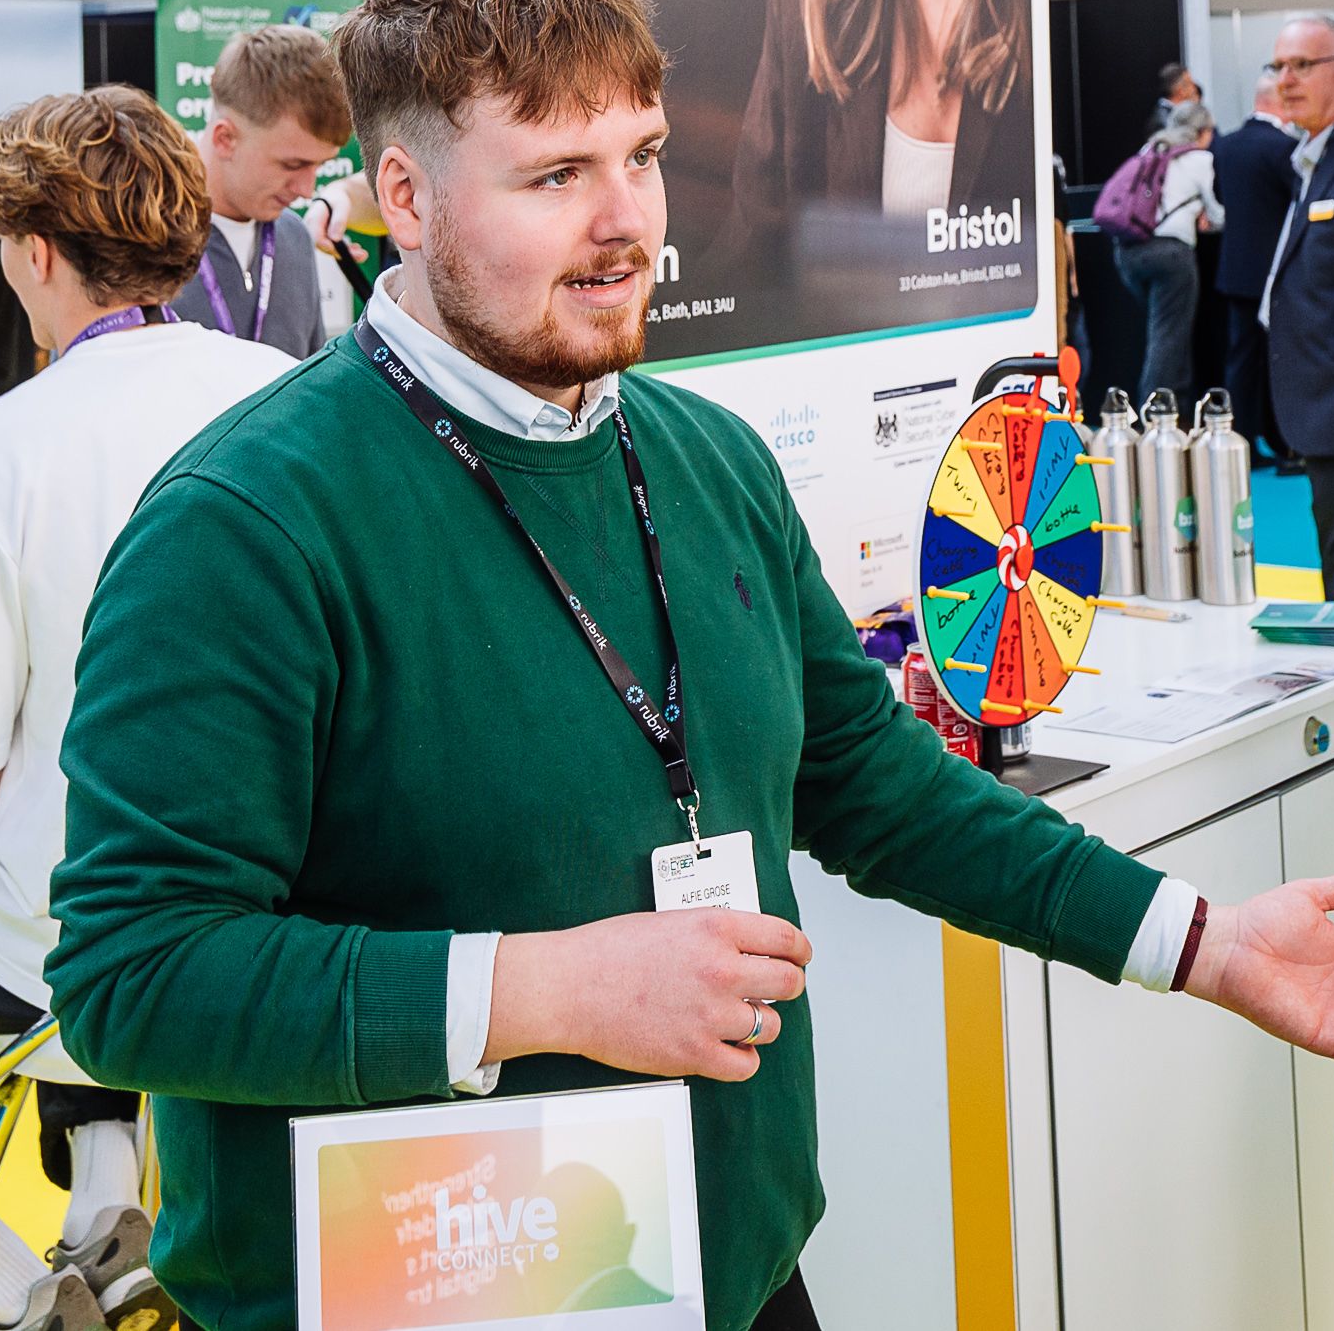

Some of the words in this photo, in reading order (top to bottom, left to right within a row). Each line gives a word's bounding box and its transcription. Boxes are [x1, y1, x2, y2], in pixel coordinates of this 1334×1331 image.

[927, 197, 1021, 253] Bristol
[662, 301, 692, 321] Bath,
[714, 296, 735, 315] 3AU
[384, 360, 415, 392] rubrik
[449, 436, 480, 471] rubrik
[775, 429, 816, 450] CISCO
[633, 485, 649, 518] rubrik
[947, 464, 978, 512] Twirl
[580, 613, 608, 651] rubrik
[639, 704, 670, 743] rubrik
[670, 858, 694, 871] CYBER
[681, 890, 703, 905] ALFIE
[703, 884, 731, 900] GROSE
[435, 1184, 558, 1250] hive
[436, 1243, 539, 1273] CONNECT
